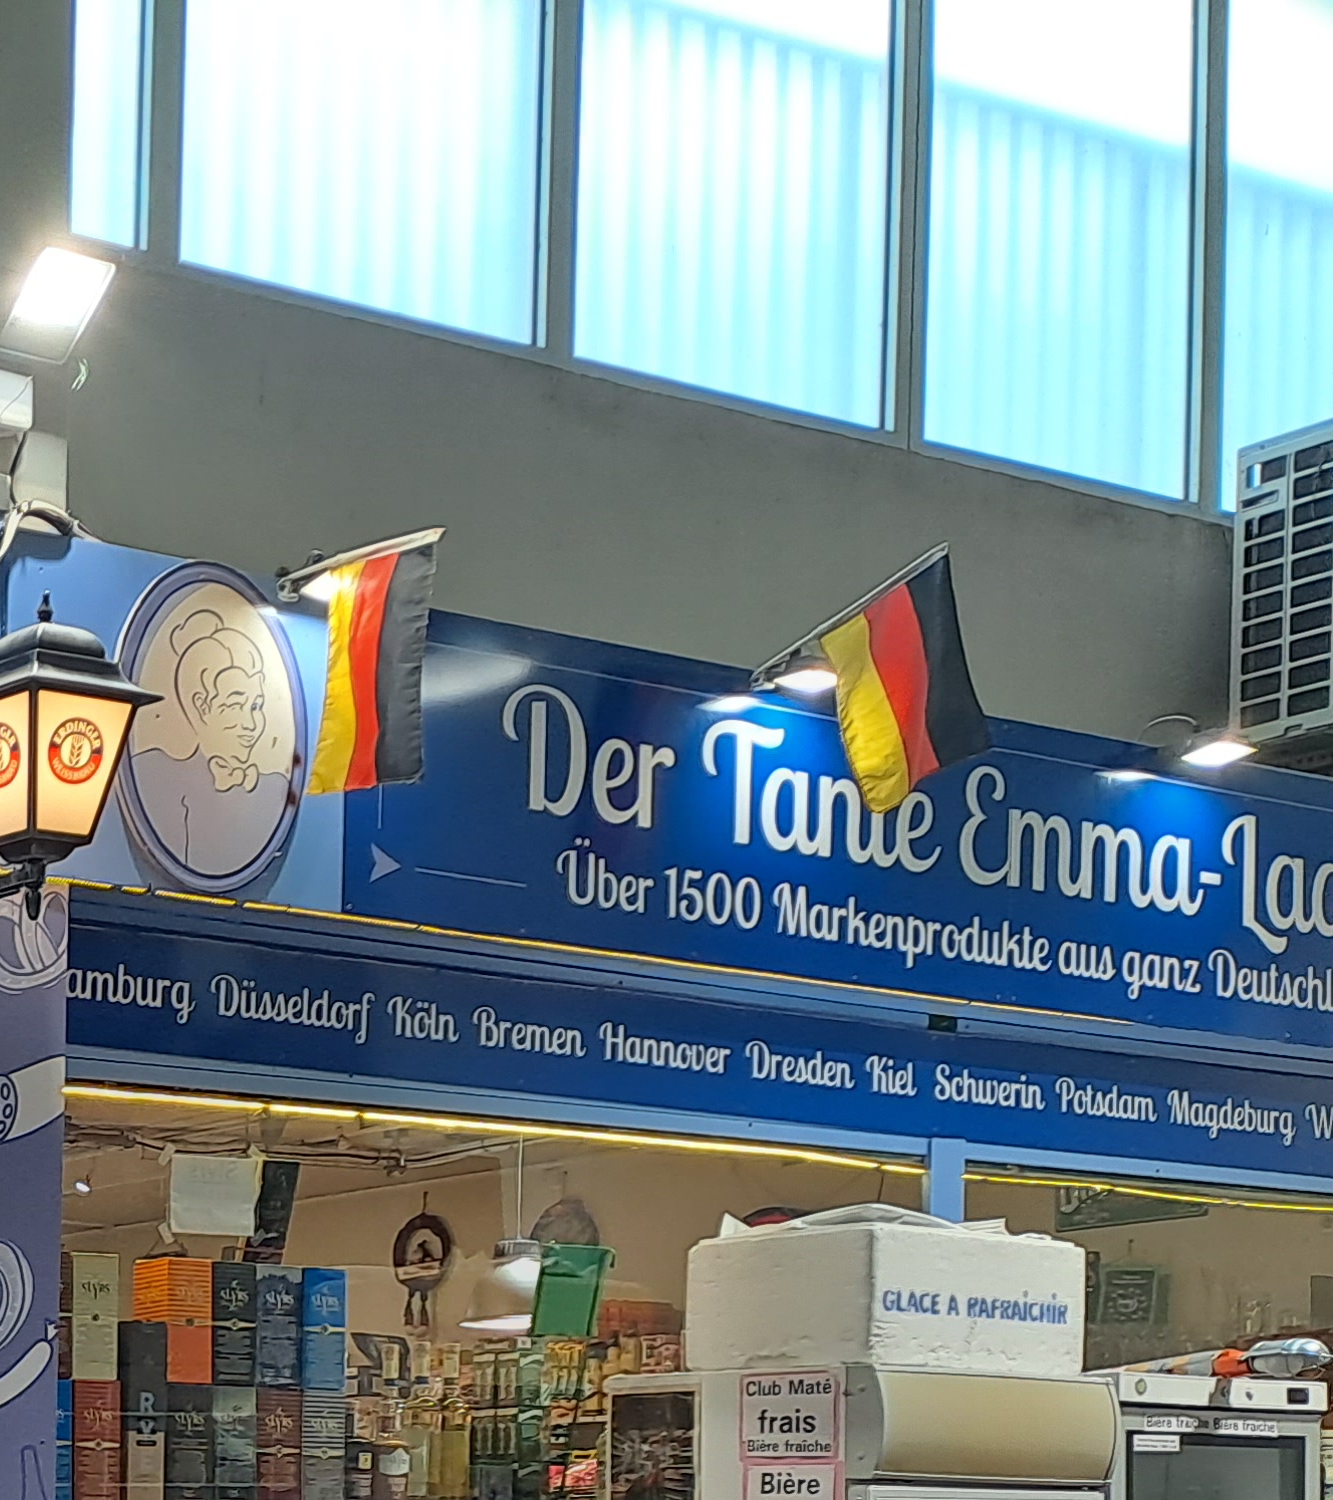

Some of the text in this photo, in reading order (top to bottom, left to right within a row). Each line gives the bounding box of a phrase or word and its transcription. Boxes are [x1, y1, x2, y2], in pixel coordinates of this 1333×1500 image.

[501, 684, 675, 829] Der
[556, 837, 650, 914] Über
[664, 866, 763, 930] 1500
[773, 882, 1053, 970] Markenprodukte
[1058, 940, 1116, 983] aus
[1122, 949, 1202, 1000] ganz
[66, 963, 1296, 1146] amburg Düsseldorf Köln Bremen Hannover Dresden Kiel Schwerin Potsdam Magdeburg
[882, 1290, 941, 1315] GLACE
[746, 1379, 832, 1396] Club Maté
[758, 1409, 816, 1434] frais
[747, 1440, 832, 1454] Bière fraîche
[761, 1472, 820, 1495] Bière
